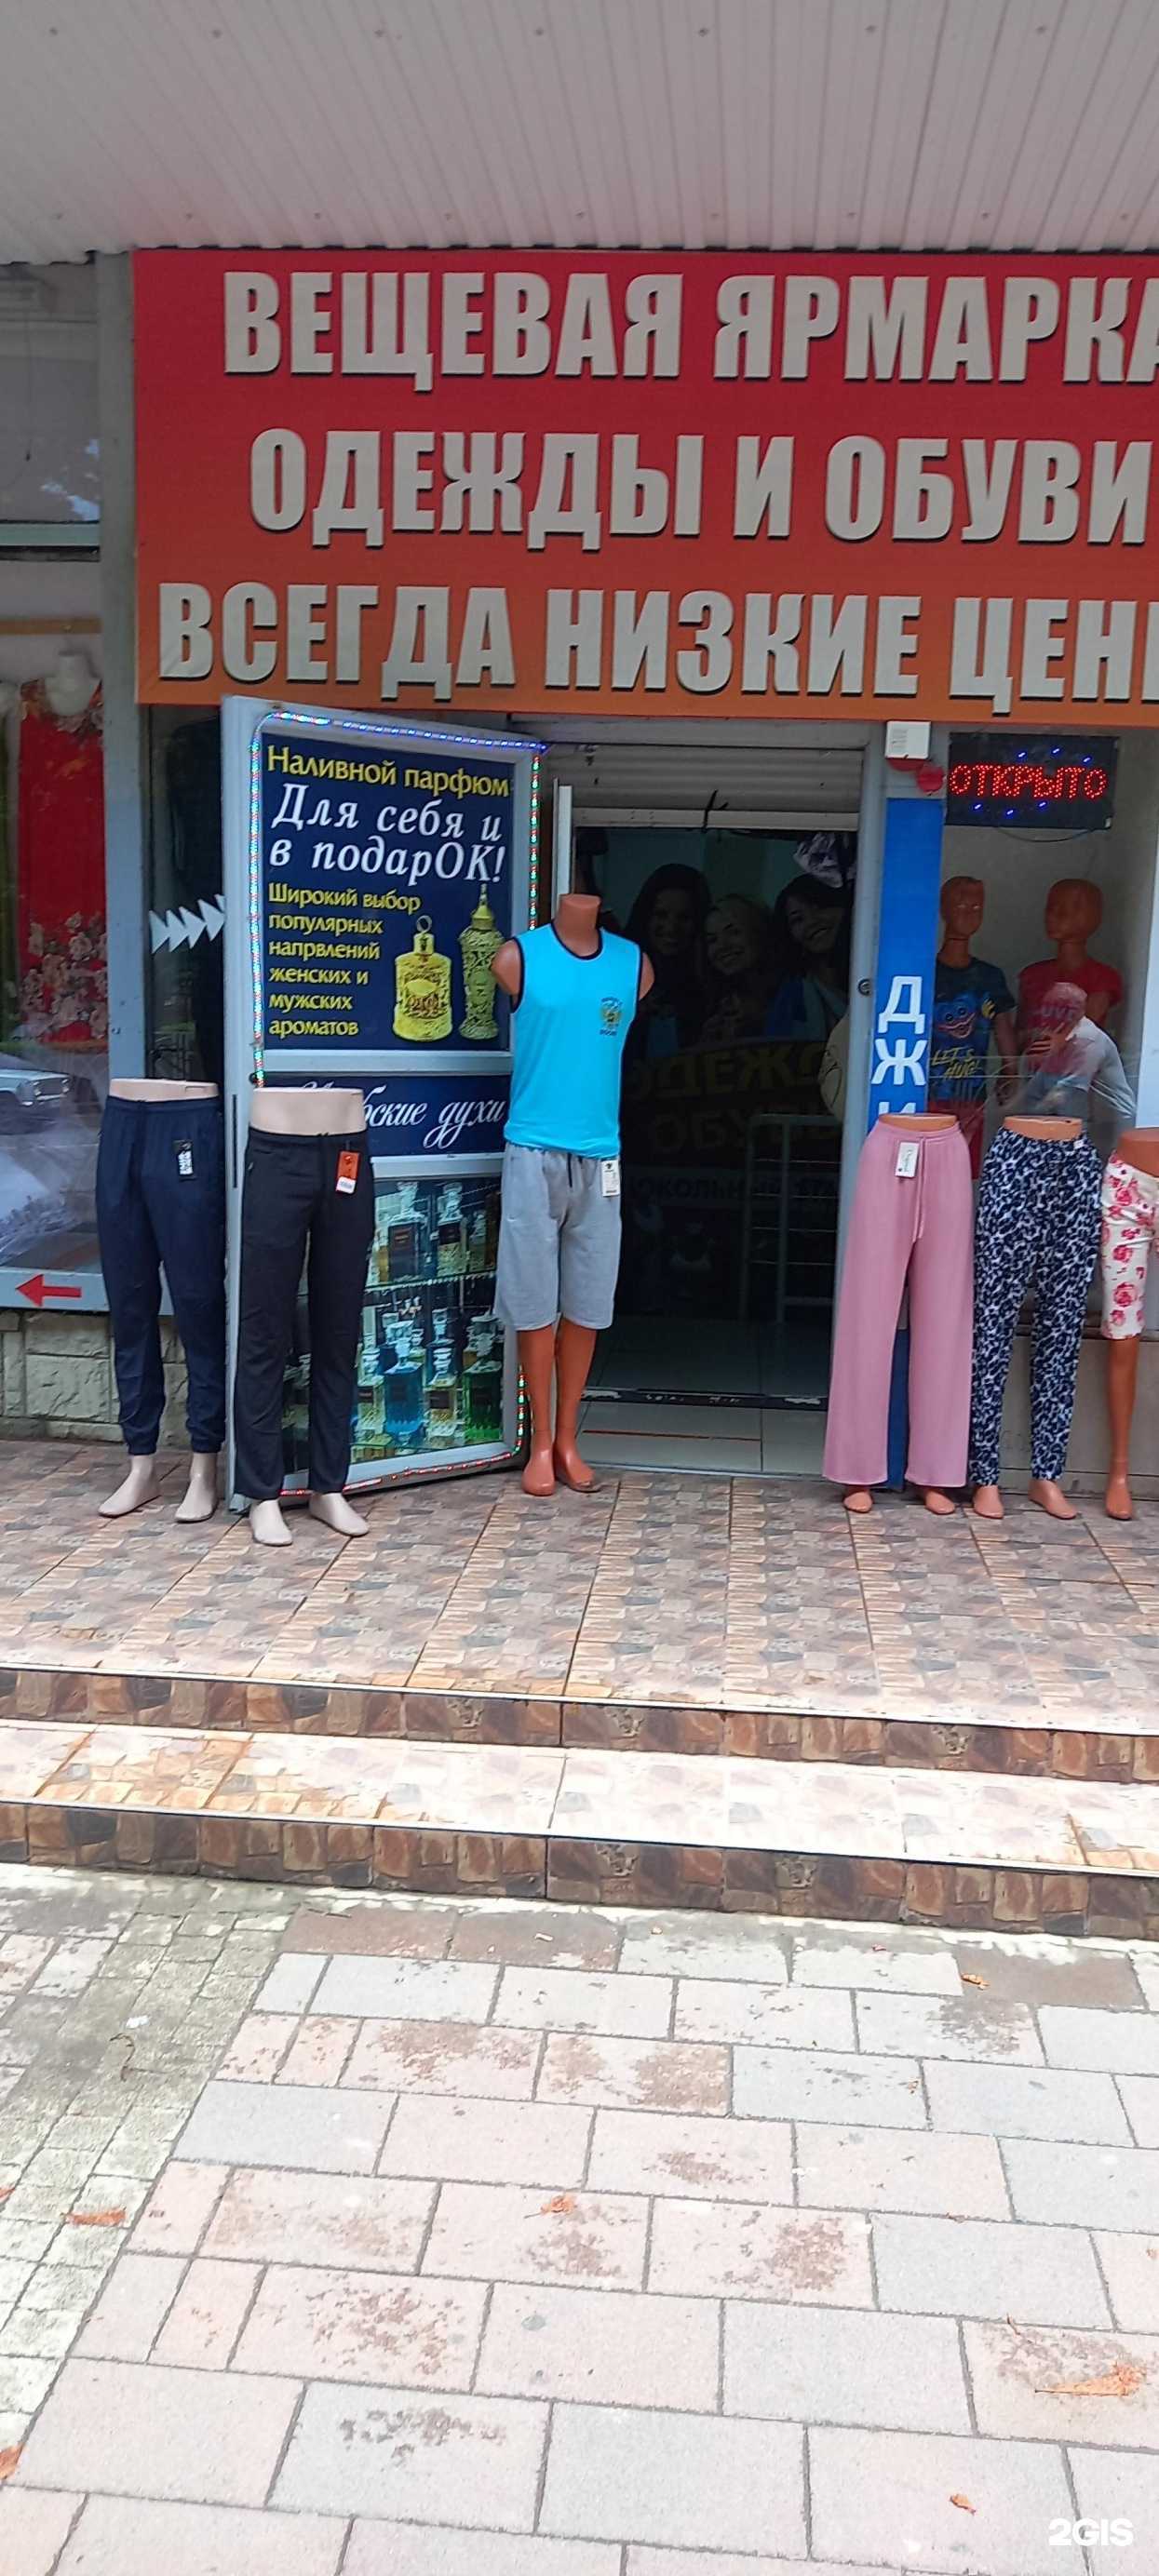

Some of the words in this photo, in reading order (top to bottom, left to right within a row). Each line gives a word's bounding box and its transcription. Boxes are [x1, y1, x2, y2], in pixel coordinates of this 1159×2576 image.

[223, 271, 683, 393] ВЕЩЕВАЯ
[249, 427, 705, 551] ОДЕЖДЫ
[733, 435, 794, 539] И
[825, 434, 1154, 545] ОБУВИ
[158, 581, 517, 702] ВСЕГДА
[544, 588, 923, 698] НИЗКИЕ
[949, 597, 1159, 716] ЦЕН
[267, 745, 397, 787] Наливной
[404, 768, 510, 799] парфюм
[949, 764, 1109, 800] ОТКРЫТО
[271, 783, 359, 832] Для
[376, 798, 464, 839] себя
[480, 814, 504, 843] и
[269, 839, 291, 867] в
[311, 835, 506, 886] подарОК!
[268, 882, 358, 909] Широкий
[362, 890, 421, 915] выбор
[268, 914, 384, 936] популярных
[268, 940, 381, 964] напрвлений
[268, 966, 352, 985] женских
[356, 974, 369, 985] и
[268, 992, 354, 1011] мужских
[268, 1019, 359, 1038] ароматов
[423, 1099, 506, 1149] духи
